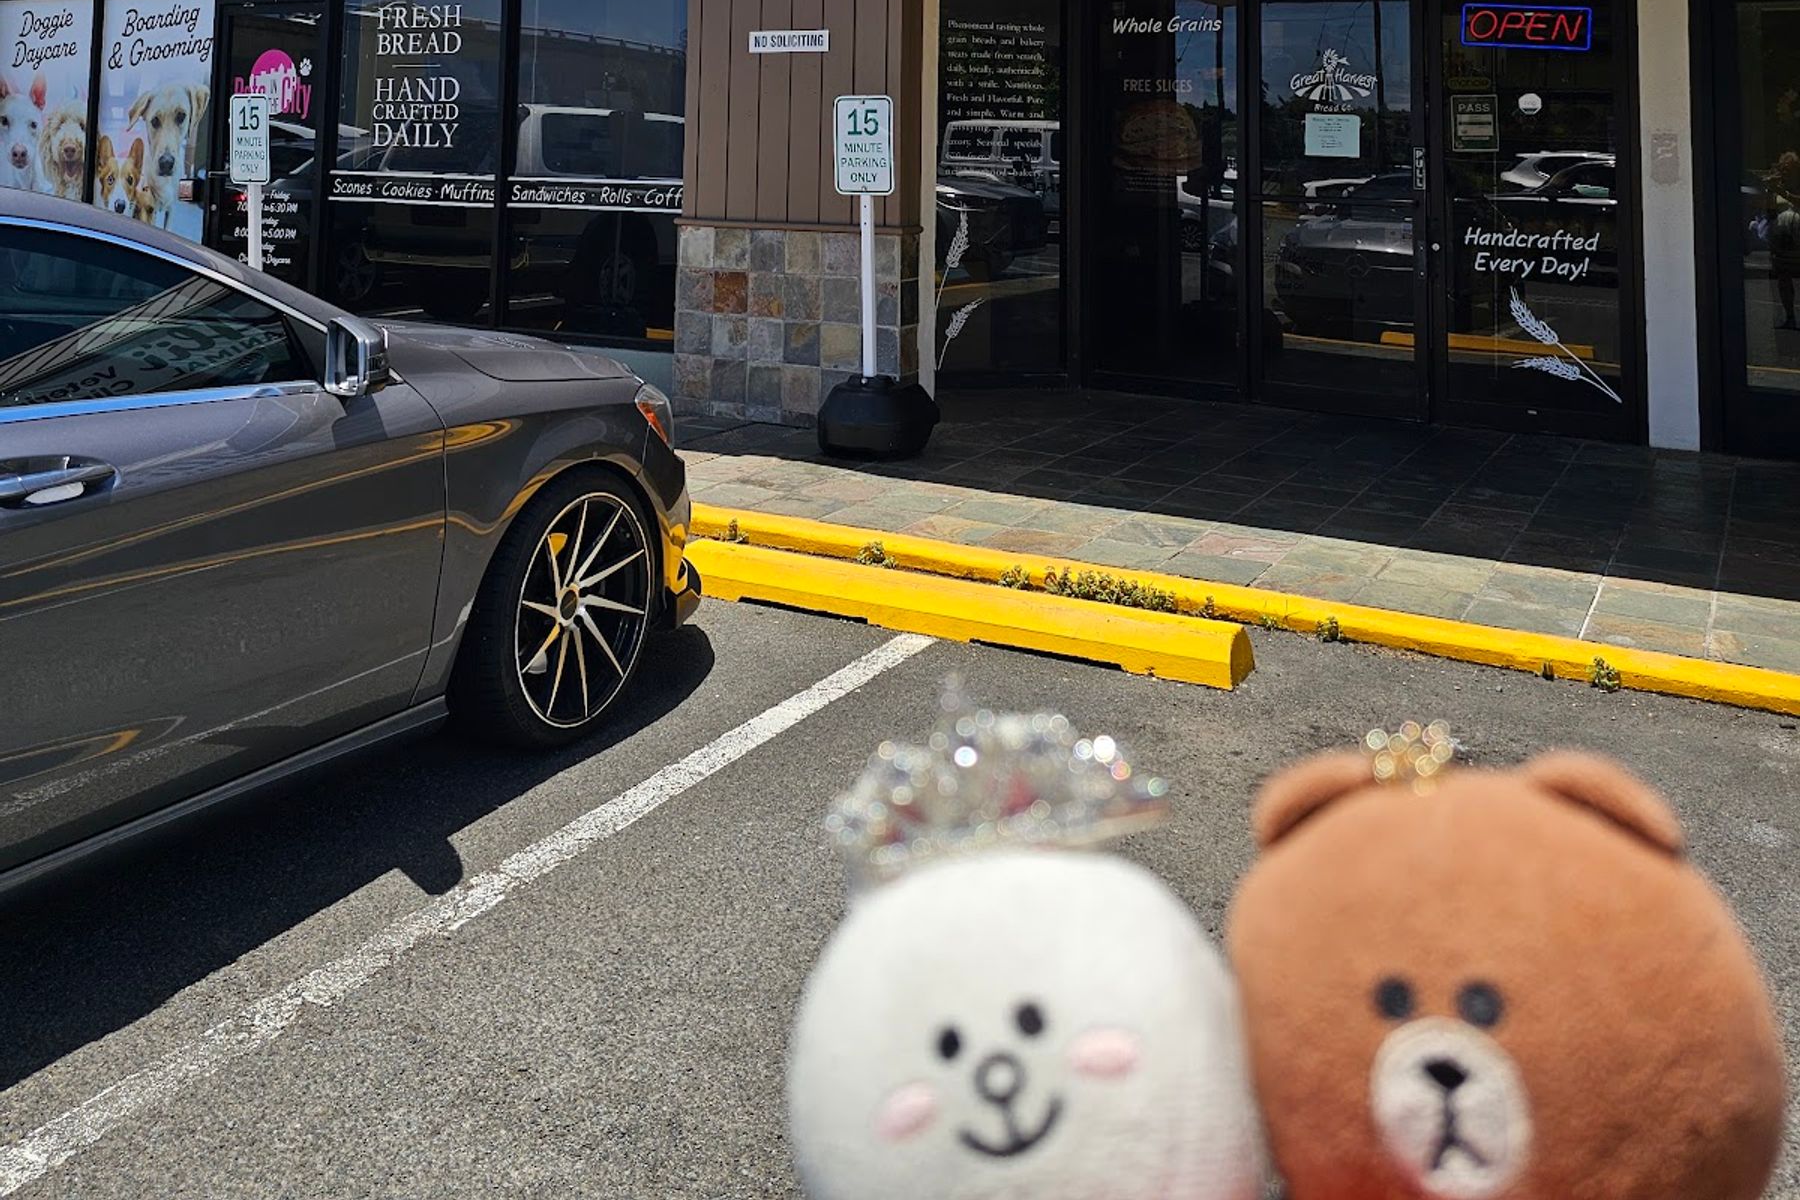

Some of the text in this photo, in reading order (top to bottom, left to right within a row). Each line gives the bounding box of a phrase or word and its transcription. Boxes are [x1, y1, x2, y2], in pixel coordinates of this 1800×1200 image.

[19, 8, 74, 40] Doggie
[122, 4, 201, 38] Boarding
[377, 4, 463, 30] FRESH
[947, 19, 1045, 33] Phenomenal tasting whole
[1112, 15, 1222, 33] Whole Grains
[1469, 10, 1584, 43] OPEN
[376, 31, 462, 56] BREAD
[754, 34, 824, 49] NO SOLICITING
[946, 35, 1045, 49] grain breads and bakery
[12, 40, 78, 70] Daycare
[107, 36, 214, 70] & Grooming
[970, 50, 992, 59] made
[994, 50, 1014, 60] from
[946, 78, 965, 87] with
[1123, 78, 1193, 93] FREE SLICES
[1290, 67, 1378, 90] Great Harvest
[281, 76, 312, 120] City
[373, 77, 460, 103] HAND
[946, 93, 969, 102] Fresh
[970, 94, 985, 103] and
[1026, 96, 1045, 105] Pure
[373, 103, 459, 120] CRAFTED
[946, 108, 961, 117] and
[1000, 110, 1025, 118] Warm
[1028, 110, 1045, 119] and
[1314, 103, 1339, 112] Bread
[1457, 103, 1491, 113] PASS
[238, 105, 260, 131] 15
[847, 108, 879, 136] 15
[237, 136, 263, 147] MINUTE
[371, 123, 460, 148] DAILY
[234, 150, 266, 161] PARKING
[844, 142, 883, 154] MINUTE
[240, 163, 260, 174] ONLY
[840, 157, 887, 169] PARKING
[1415, 150, 1424, 187] PULL
[850, 172, 877, 183] ONLY
[332, 178, 495, 201] Scones Cookies Muffins
[511, 184, 683, 207] Sandwiches Rolls Coff
[1464, 226, 1600, 251] Handcrafted
[1474, 252, 1590, 282] Every Day!
